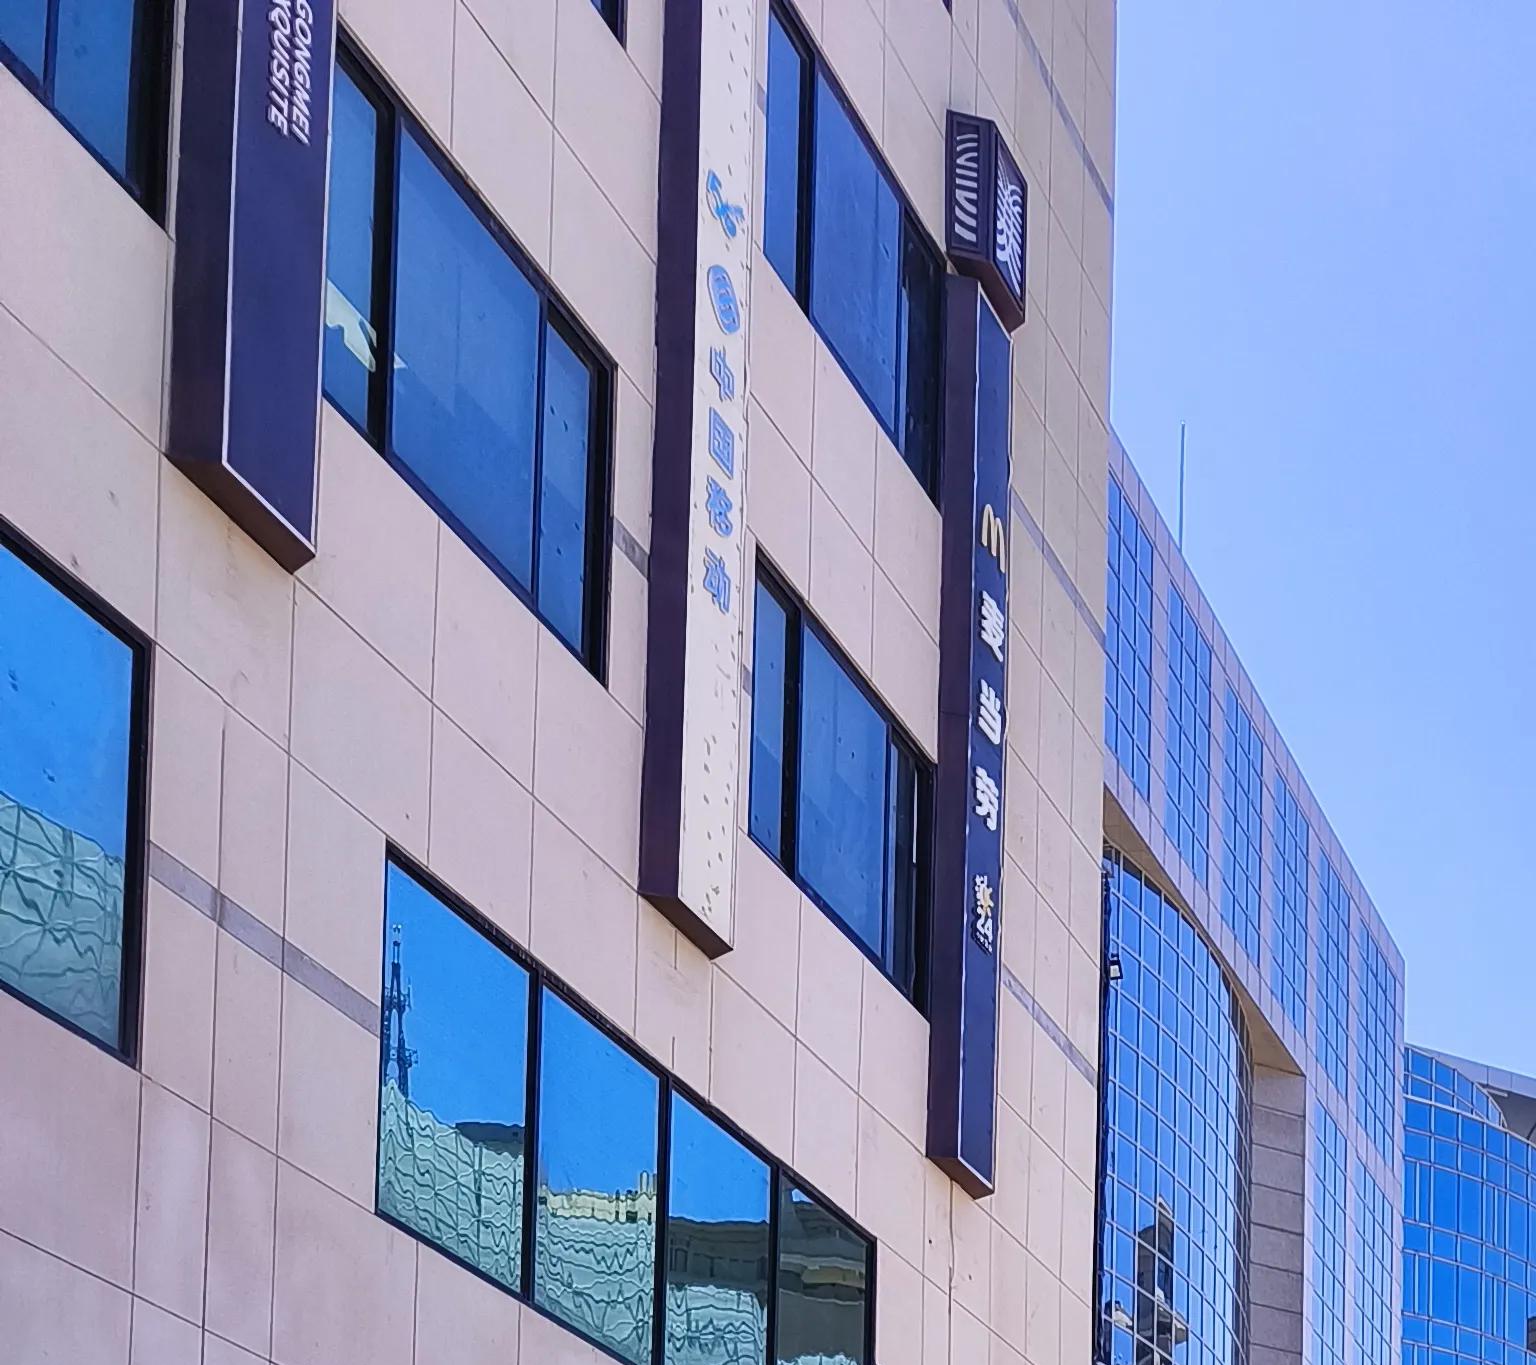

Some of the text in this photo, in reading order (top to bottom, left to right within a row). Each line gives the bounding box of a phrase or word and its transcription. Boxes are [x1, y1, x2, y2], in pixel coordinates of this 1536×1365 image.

[703, 345, 735, 615] 中国移动
[974, 590, 1004, 833] 麦当劳
